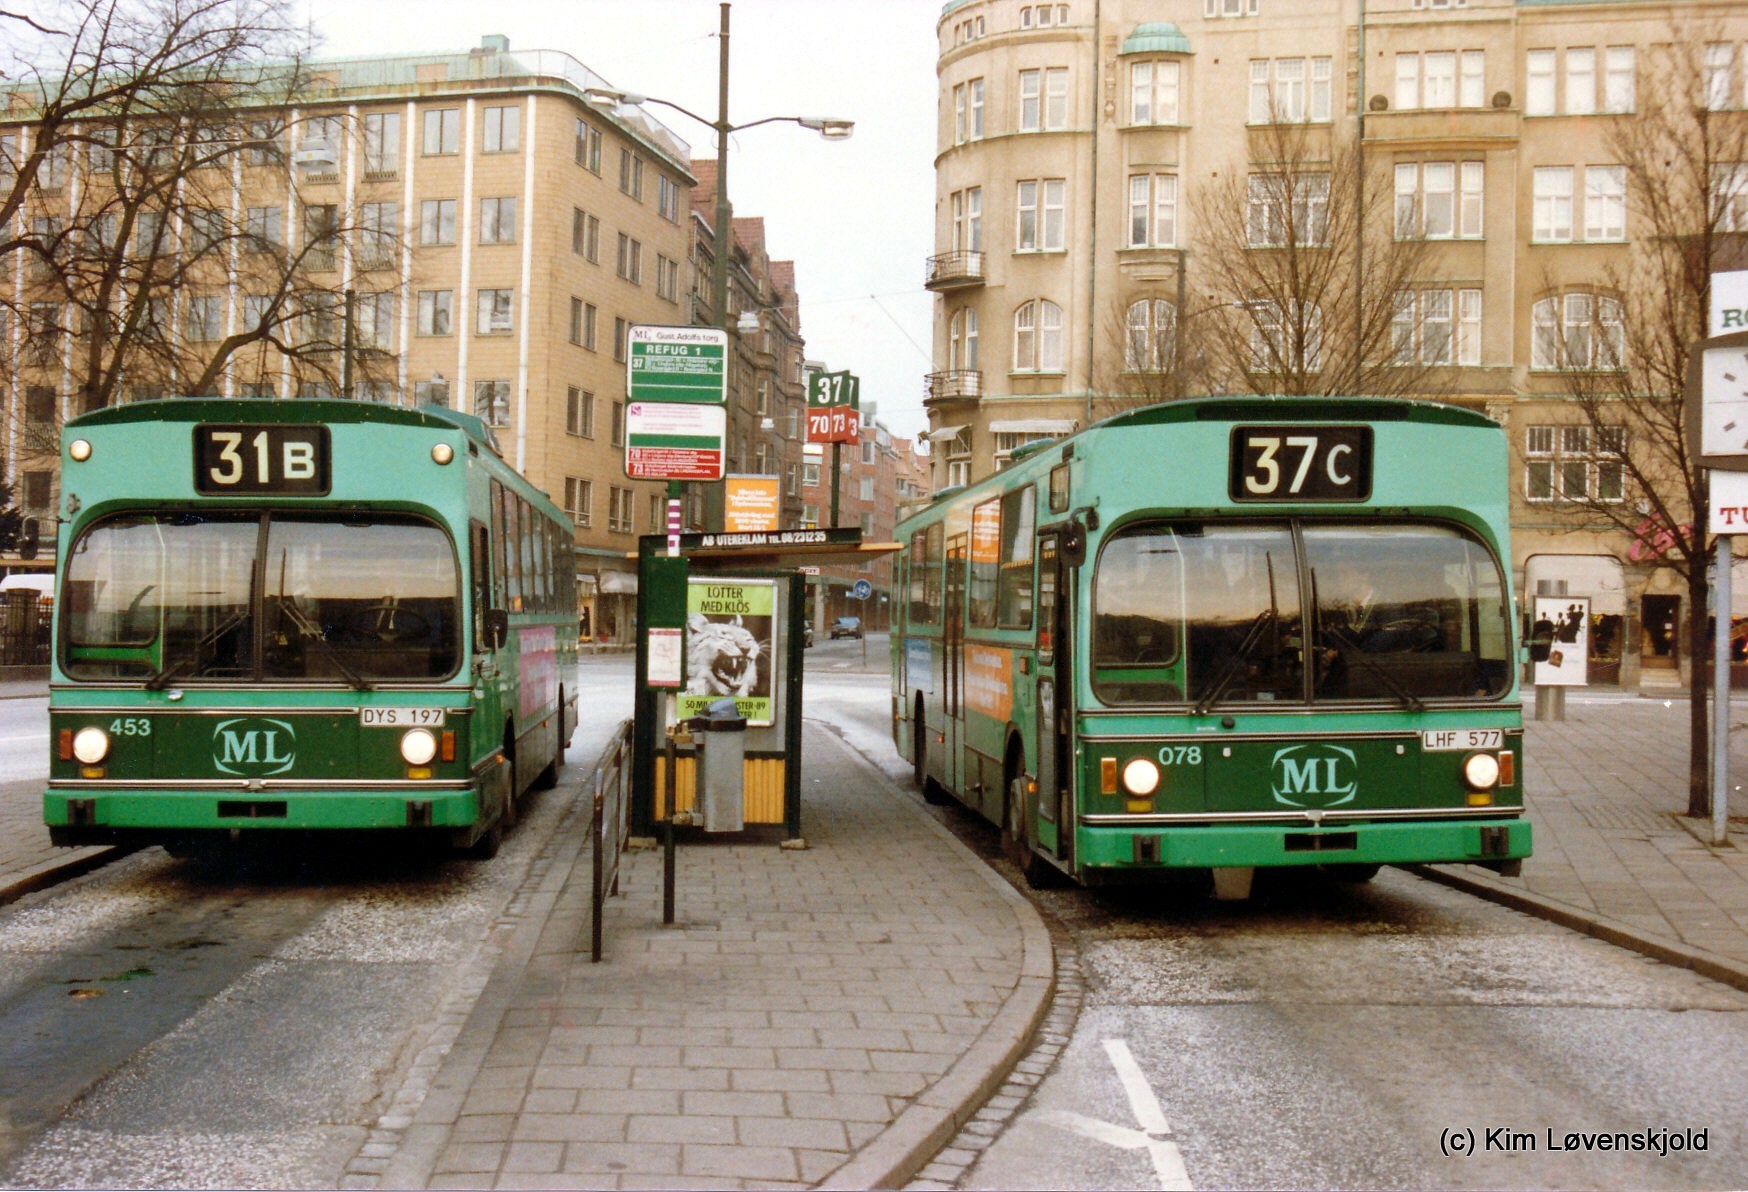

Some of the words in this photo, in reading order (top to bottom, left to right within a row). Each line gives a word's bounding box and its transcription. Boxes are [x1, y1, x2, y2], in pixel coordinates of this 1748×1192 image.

[1722, 308, 1748, 328] R
[703, 335, 719, 343] torg
[646, 345, 688, 355] REFUG
[695, 347, 701, 356] 1
[633, 358, 643, 368] 37
[818, 375, 843, 404] 37
[811, 415, 829, 434] 70
[833, 413, 845, 433] 73
[630, 449, 641, 459] 70
[633, 464, 644, 474] 73
[702, 535, 714, 547] AB
[716, 533, 767, 547] UTEREKLAM
[707, 586, 743, 599] LOTTER
[700, 600, 723, 613] MED
[724, 599, 750, 613] KLÖS
[685, 700, 695, 709] 50
[364, 709, 397, 723] DYS
[411, 709, 442, 723] 197
[109, 718, 151, 736] 453
[1425, 732, 1457, 747] LHF
[1469, 731, 1500, 746] 577
[221, 730, 292, 763] ML
[1158, 745, 1202, 765] 078
[1280, 758, 1354, 793] ML
